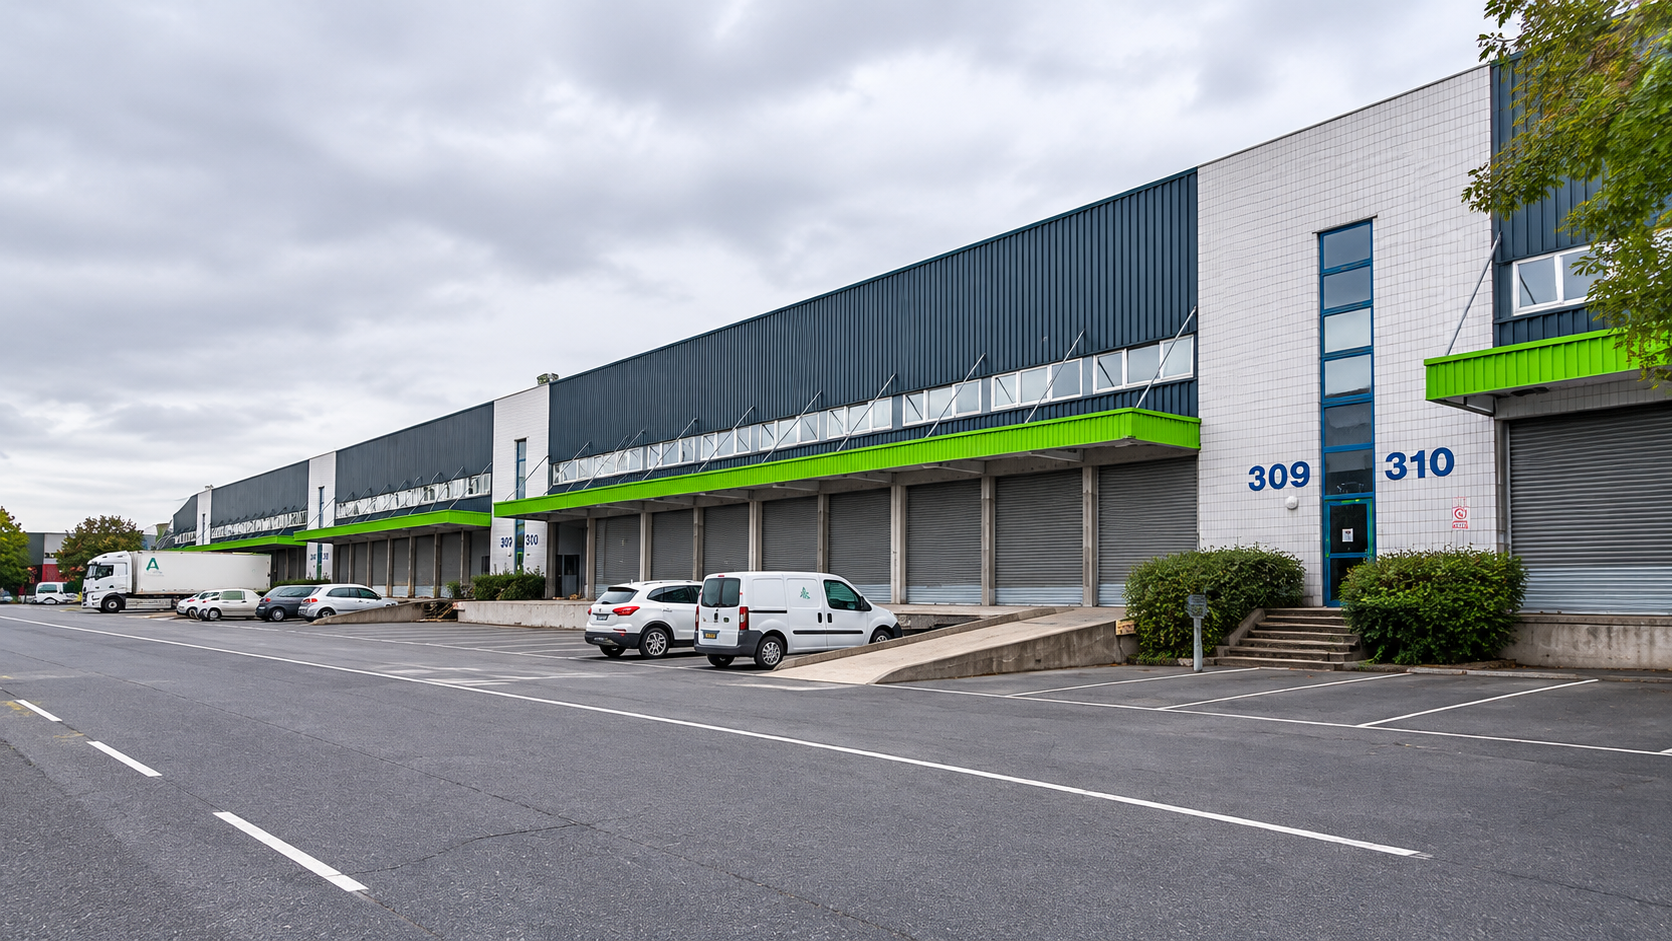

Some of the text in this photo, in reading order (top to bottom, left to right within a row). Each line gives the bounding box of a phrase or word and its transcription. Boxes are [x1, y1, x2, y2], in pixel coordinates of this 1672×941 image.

[1248, 460, 1310, 491] 309
[1384, 447, 1455, 480] 310
[146, 557, 159, 571] A
